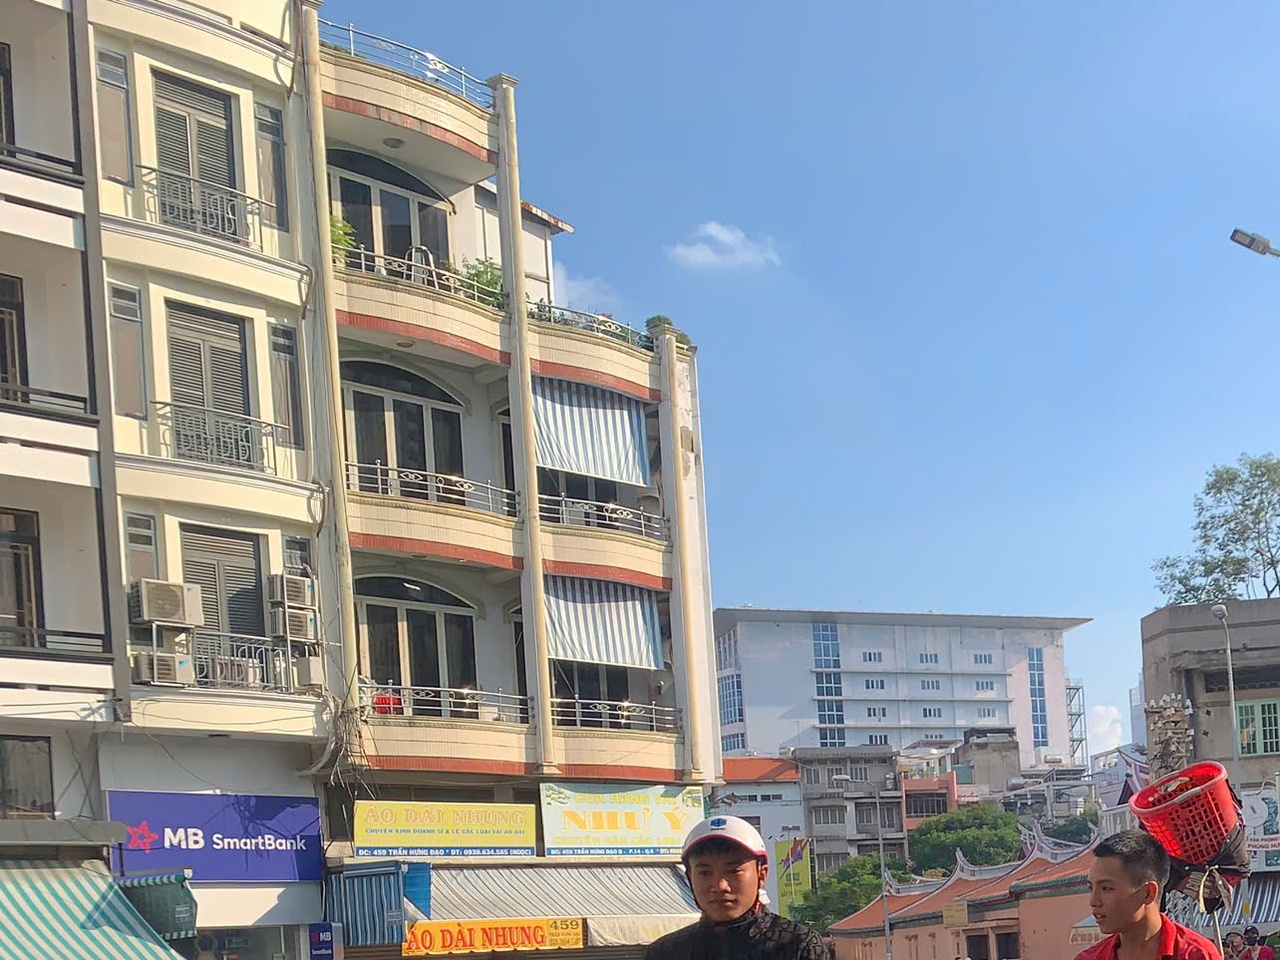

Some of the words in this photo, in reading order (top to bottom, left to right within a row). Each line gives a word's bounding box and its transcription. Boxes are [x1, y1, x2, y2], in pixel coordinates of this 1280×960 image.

[404, 805, 445, 826] DÀI
[452, 808, 528, 827] NHUNG
[562, 807, 652, 832] NHƯ
[163, 827, 205, 850] MB
[212, 834, 307, 851] SmartBank
[388, 847, 408, 856] TRẦN
[319, 931, 332, 941] MB
[550, 920, 580, 930] 459
[406, 926, 433, 950] ÁO
[440, 923, 474, 949] DÀI
[481, 925, 546, 948] NHUNG
